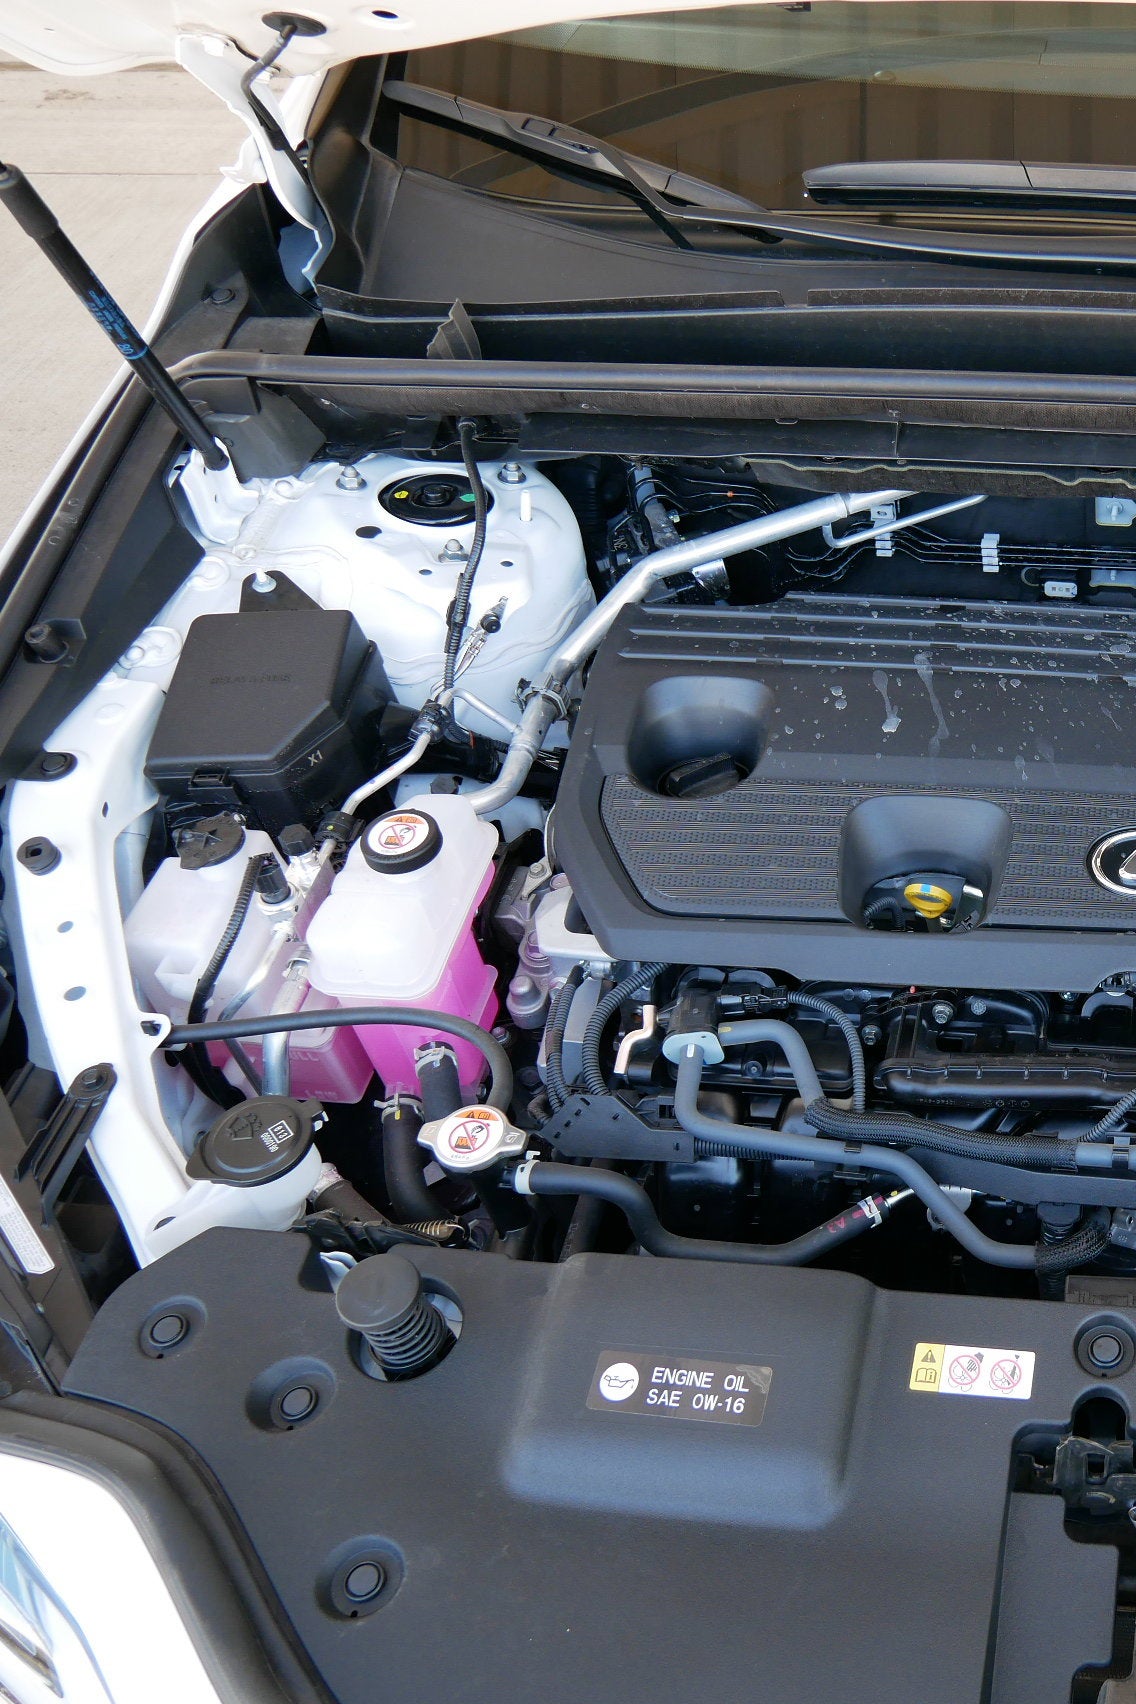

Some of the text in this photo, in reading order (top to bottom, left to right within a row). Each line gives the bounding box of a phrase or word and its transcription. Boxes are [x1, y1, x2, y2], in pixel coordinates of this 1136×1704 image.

[307, 750, 323, 766] X1
[652, 1366, 750, 1393] ENGINE OIL
[646, 1389, 746, 1414] SAE 0W-16
